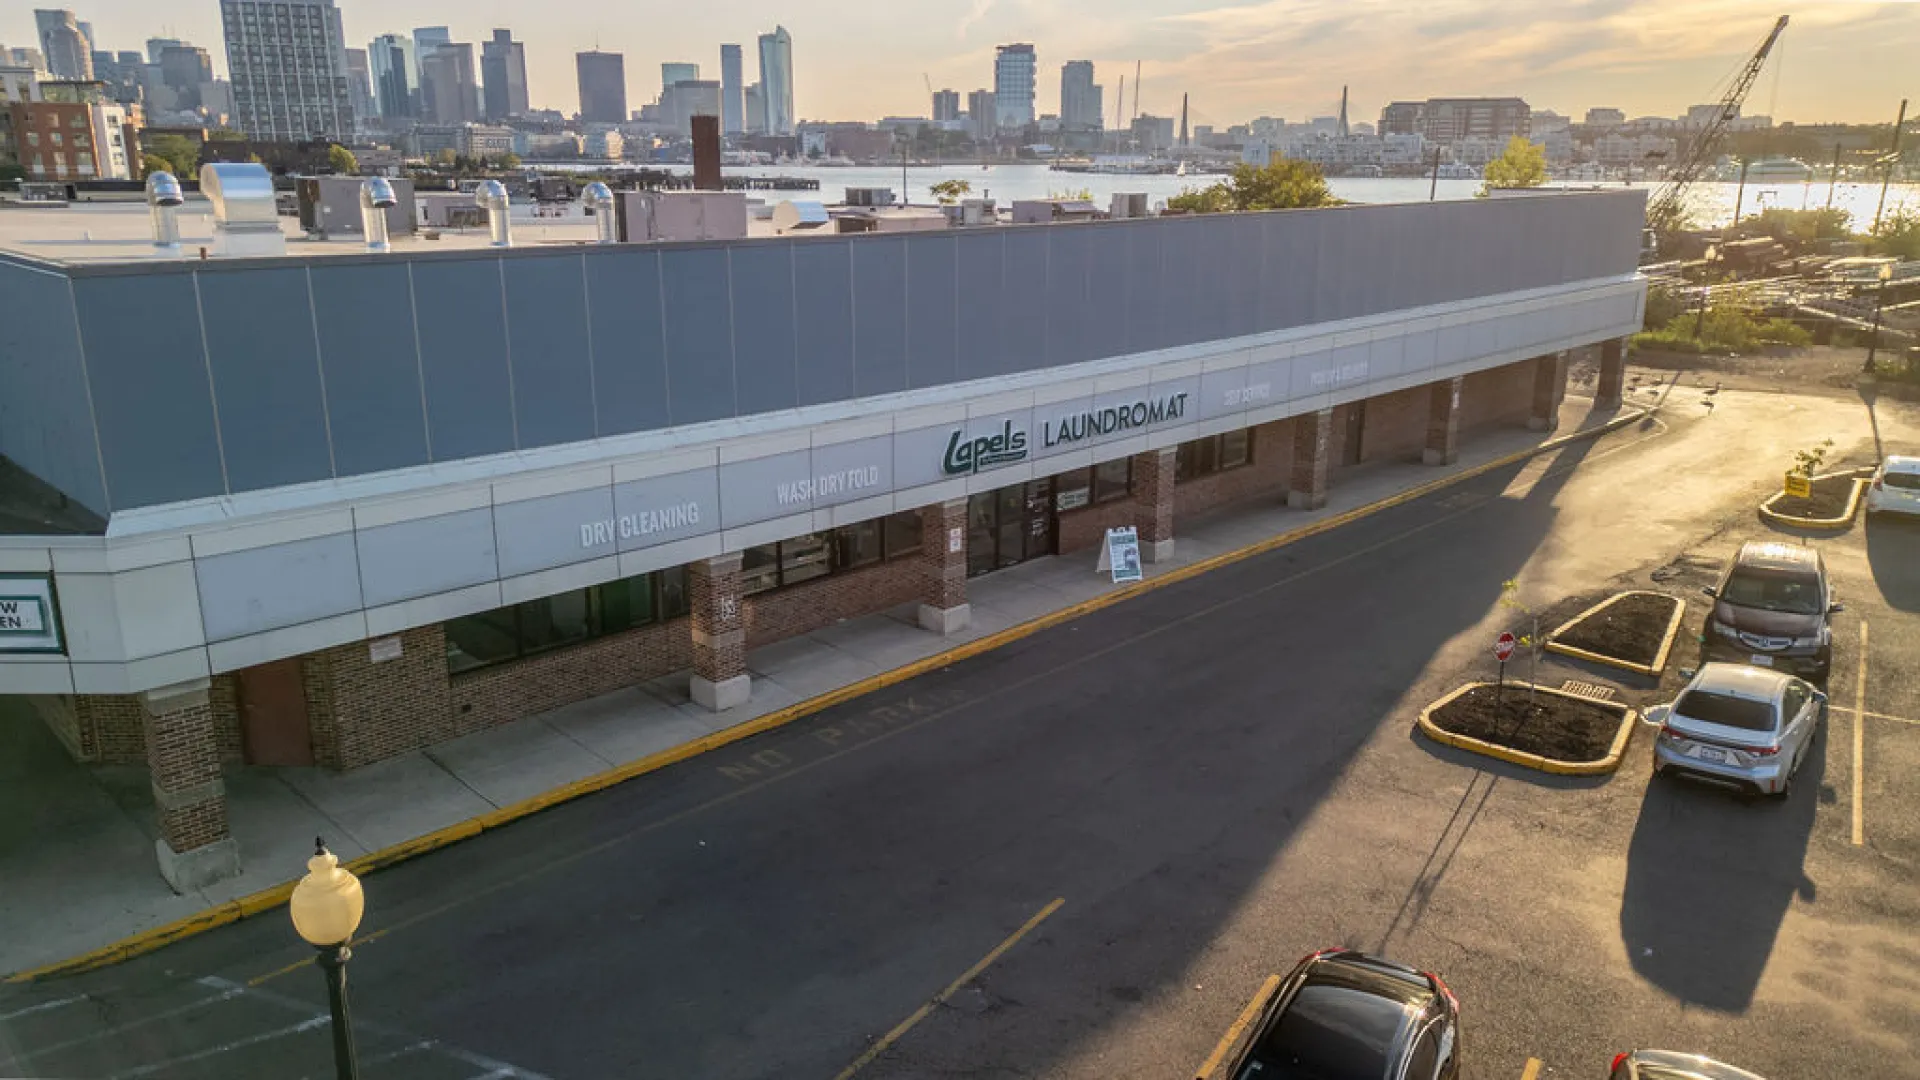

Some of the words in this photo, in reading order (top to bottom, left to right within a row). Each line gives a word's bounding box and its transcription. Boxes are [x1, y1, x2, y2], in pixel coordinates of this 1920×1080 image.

[1043, 393, 1187, 447] LAUNDROMAT
[945, 420, 1026, 475] Lapels
[777, 479, 815, 504] WASH
[820, 472, 847, 496] DRY
[849, 466, 878, 489] FOLD
[580, 517, 615, 548] DRY
[619, 502, 699, 538] CLEANING
